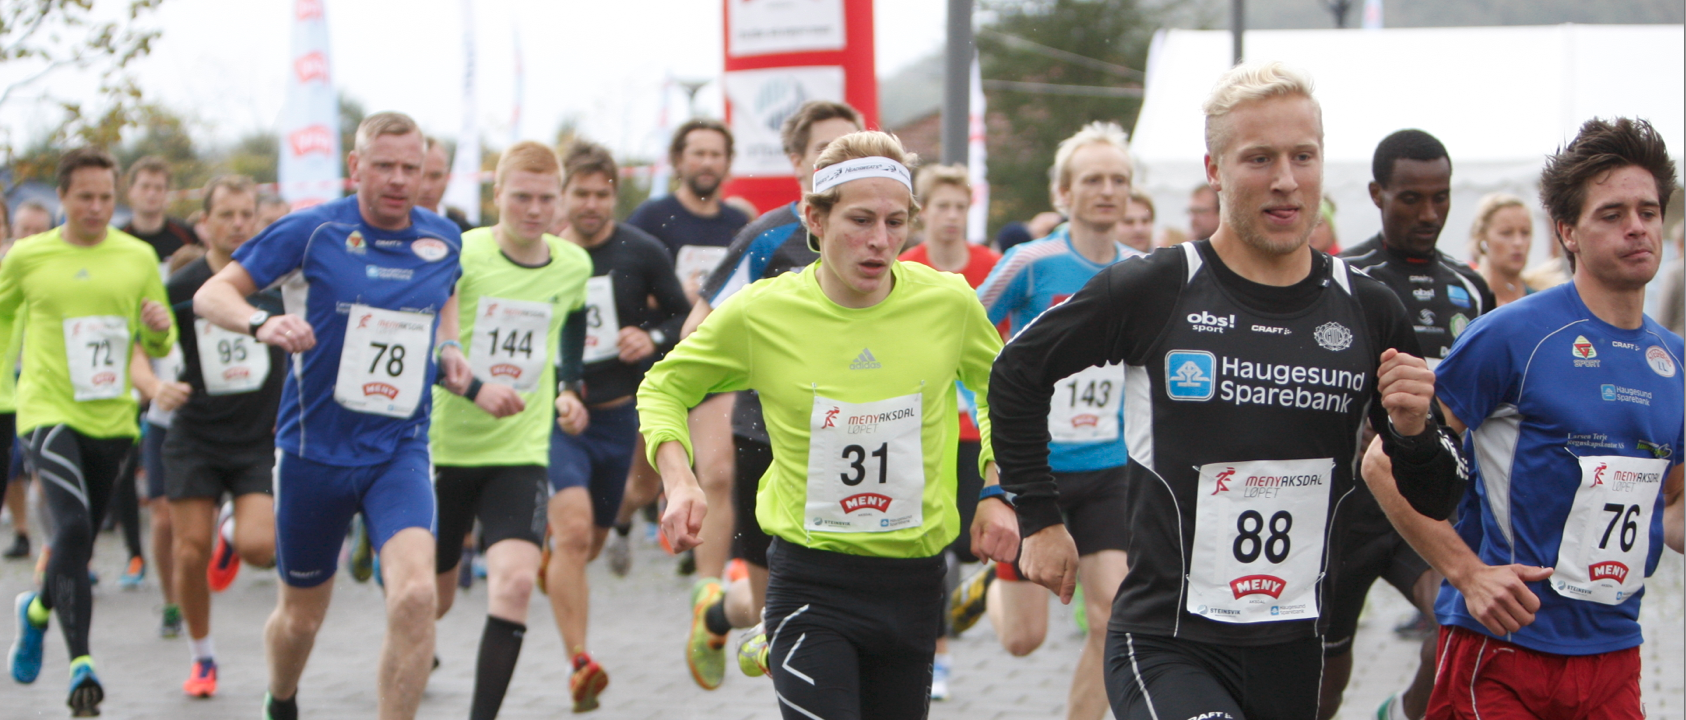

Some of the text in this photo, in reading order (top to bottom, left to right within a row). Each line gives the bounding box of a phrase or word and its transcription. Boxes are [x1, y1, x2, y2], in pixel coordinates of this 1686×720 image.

[1187, 311, 1235, 328] obs!
[1192, 324, 1224, 334] sport
[1251, 324, 1284, 334] CRAFT
[218, 336, 248, 364] 95
[488, 327, 534, 359] 144
[1612, 340, 1634, 350] CRAFT
[86, 339, 114, 367] 72
[368, 341, 406, 378] 78
[849, 361, 882, 370] adidas
[1573, 359, 1600, 368] SPORT
[1222, 356, 1366, 392] Haugesund
[1067, 380, 1112, 408] 143
[1220, 380, 1353, 413] Sparebank
[1616, 386, 1653, 399] Haugesund
[1616, 393, 1651, 407] Sparebank
[847, 423, 879, 435] LØPET
[840, 442, 888, 487] 31
[1243, 486, 1281, 498] LØPET
[845, 495, 887, 509] MENY
[1598, 503, 1640, 553] 76
[1232, 509, 1293, 564] 88
[1594, 564, 1626, 578] MENY
[1236, 578, 1282, 594] MENY
[1210, 607, 1241, 615] STEINSVIK
